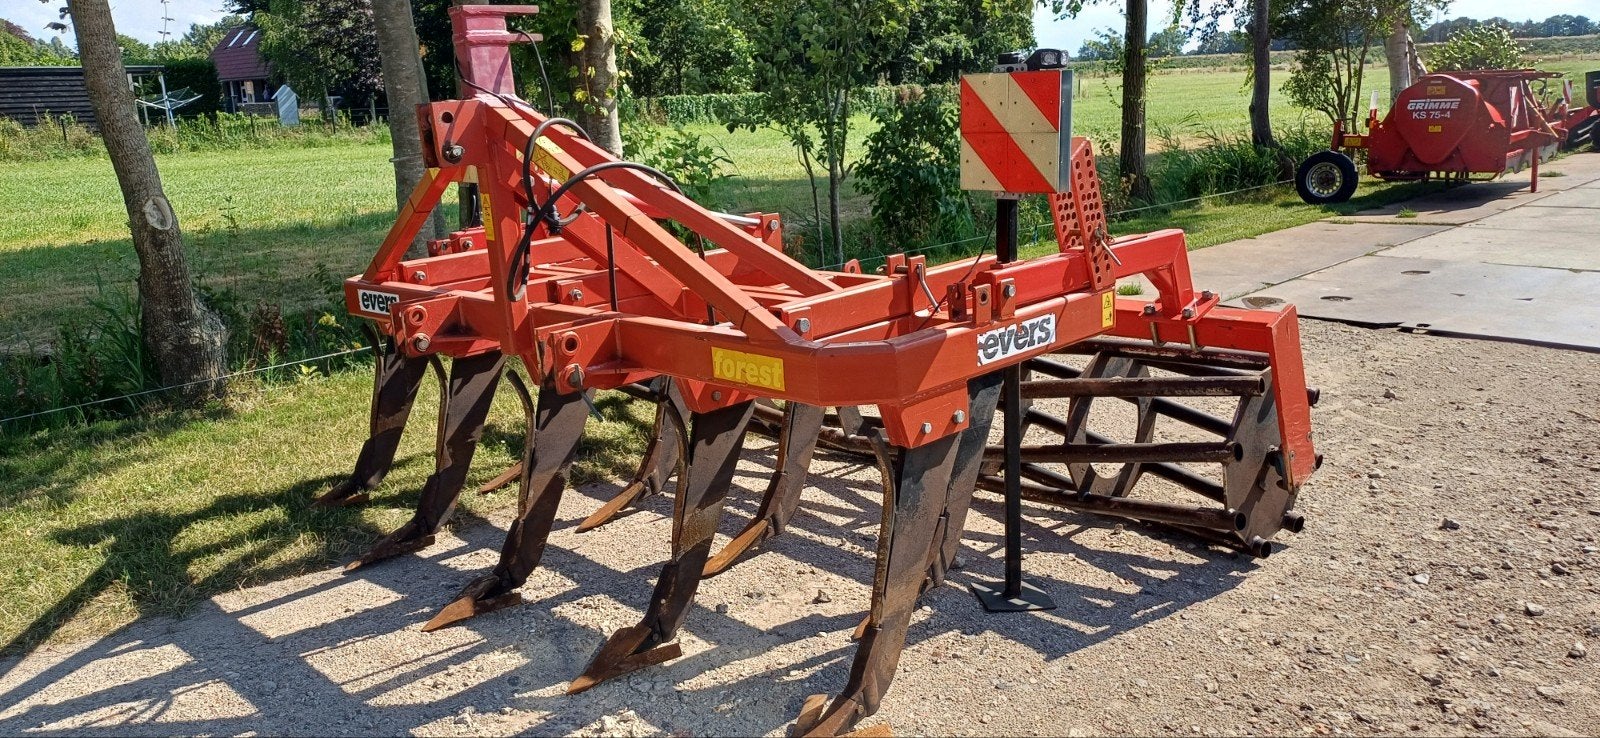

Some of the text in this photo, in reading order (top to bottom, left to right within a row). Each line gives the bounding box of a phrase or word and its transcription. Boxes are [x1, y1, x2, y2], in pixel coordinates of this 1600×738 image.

[1407, 100, 1460, 110] GRIMME
[1412, 111, 1451, 120] KS 75-4
[983, 317, 1051, 360] evers
[714, 350, 782, 388] forest
